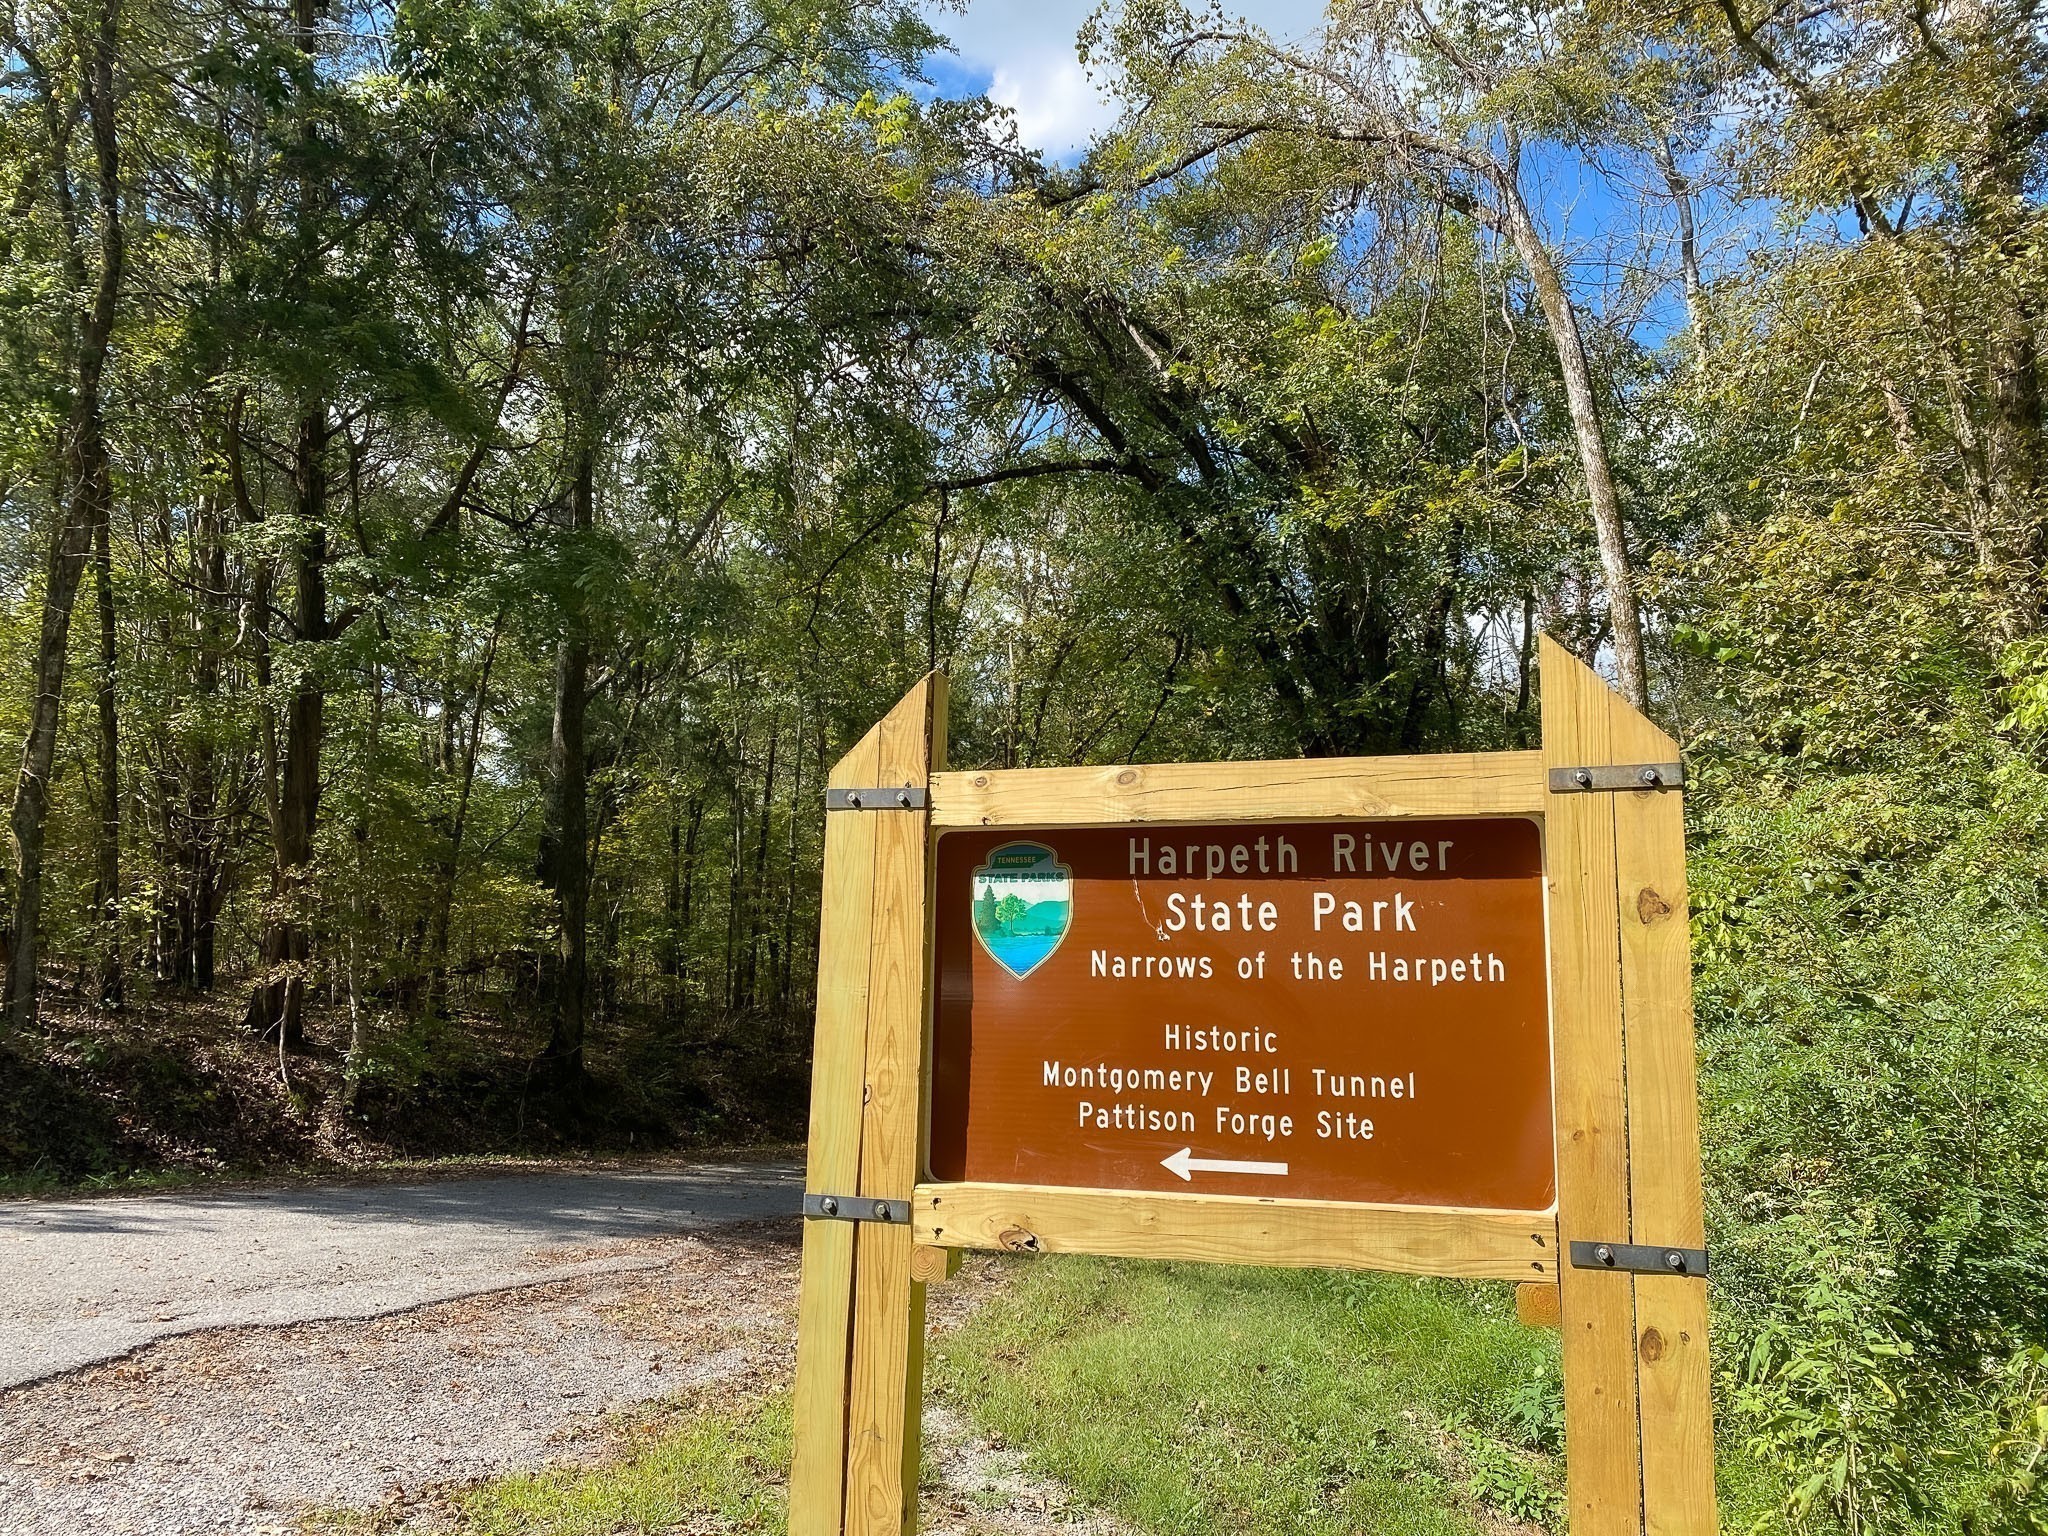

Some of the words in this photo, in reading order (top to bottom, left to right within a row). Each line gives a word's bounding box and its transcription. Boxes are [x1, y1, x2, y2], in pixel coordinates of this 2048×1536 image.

[997, 856, 1037, 864] TENNESSEE
[1130, 835, 1298, 880] Harpeth
[1333, 833, 1454, 872] River
[978, 872, 1018, 884] STATE
[1021, 871, 1064, 883] PARKS
[1165, 893, 1278, 932] State
[1313, 892, 1417, 932] Park
[1091, 949, 1213, 979] Narrows
[1237, 950, 1266, 979] of
[1290, 951, 1343, 980] the
[1369, 951, 1505, 987] Harpeth
[1165, 1024, 1277, 1053] Historic
[1043, 1060, 1214, 1097] Montgomery
[1236, 1066, 1289, 1095] Bell
[1312, 1068, 1415, 1099] Tunnel
[1079, 1101, 1195, 1132] Pattison
[1216, 1106, 1293, 1142] Forge
[1316, 1110, 1374, 1140] Site
